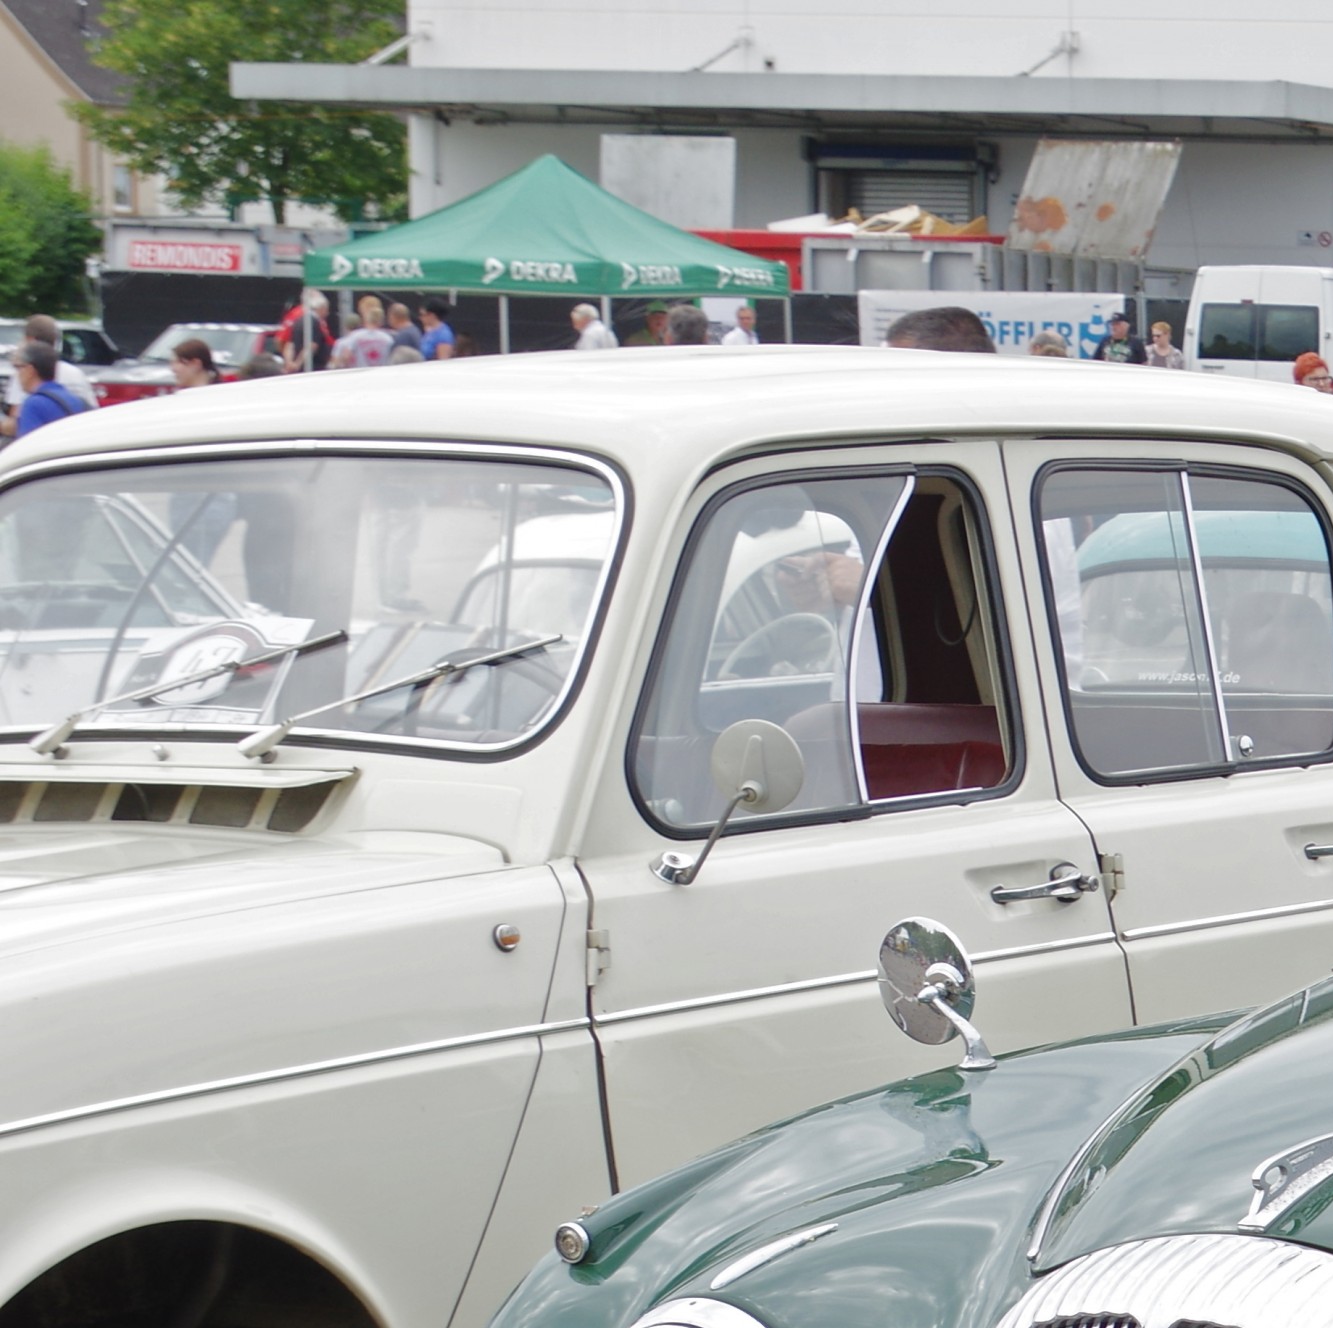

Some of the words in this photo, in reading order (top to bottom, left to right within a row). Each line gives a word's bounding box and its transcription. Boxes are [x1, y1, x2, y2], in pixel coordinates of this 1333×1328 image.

[133, 243, 234, 270] REMONDIS
[357, 257, 424, 279] DEKRA
[509, 260, 579, 284] DEKRA
[638, 264, 683, 285] DEKRA
